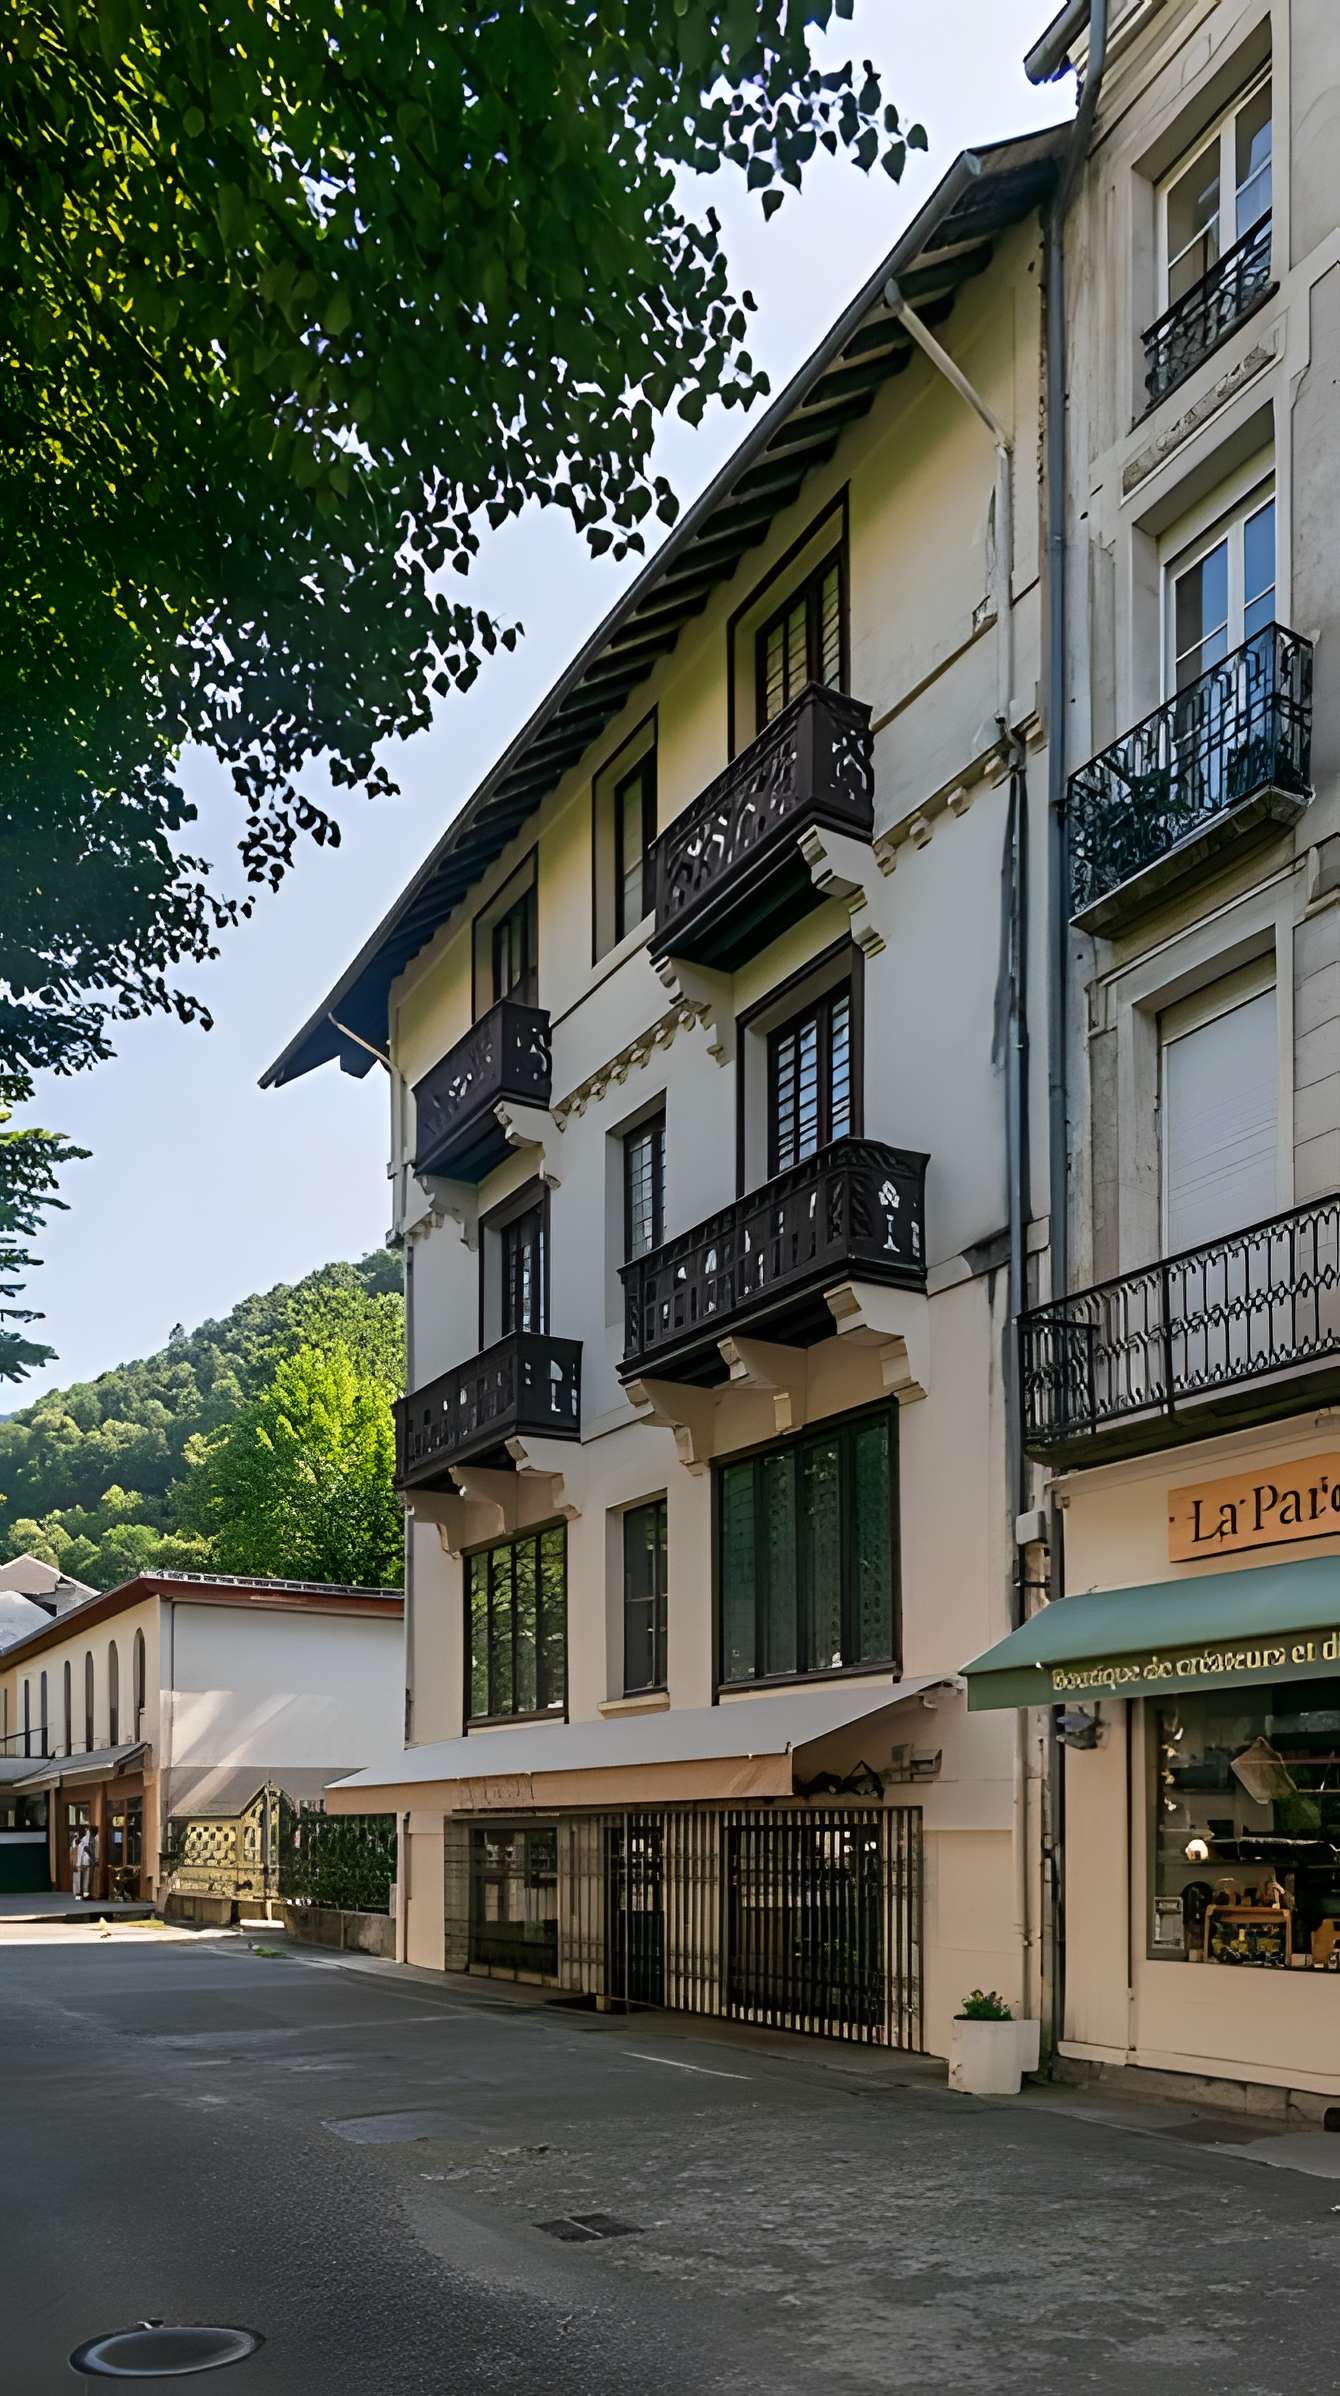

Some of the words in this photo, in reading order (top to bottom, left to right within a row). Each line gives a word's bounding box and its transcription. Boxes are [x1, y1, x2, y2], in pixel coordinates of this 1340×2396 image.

[1191, 1499, 1238, 1542] La
[1052, 1664, 1140, 1690] Boutique
[1143, 1655, 1173, 1679] de
[1291, 1642, 1316, 1664] et
